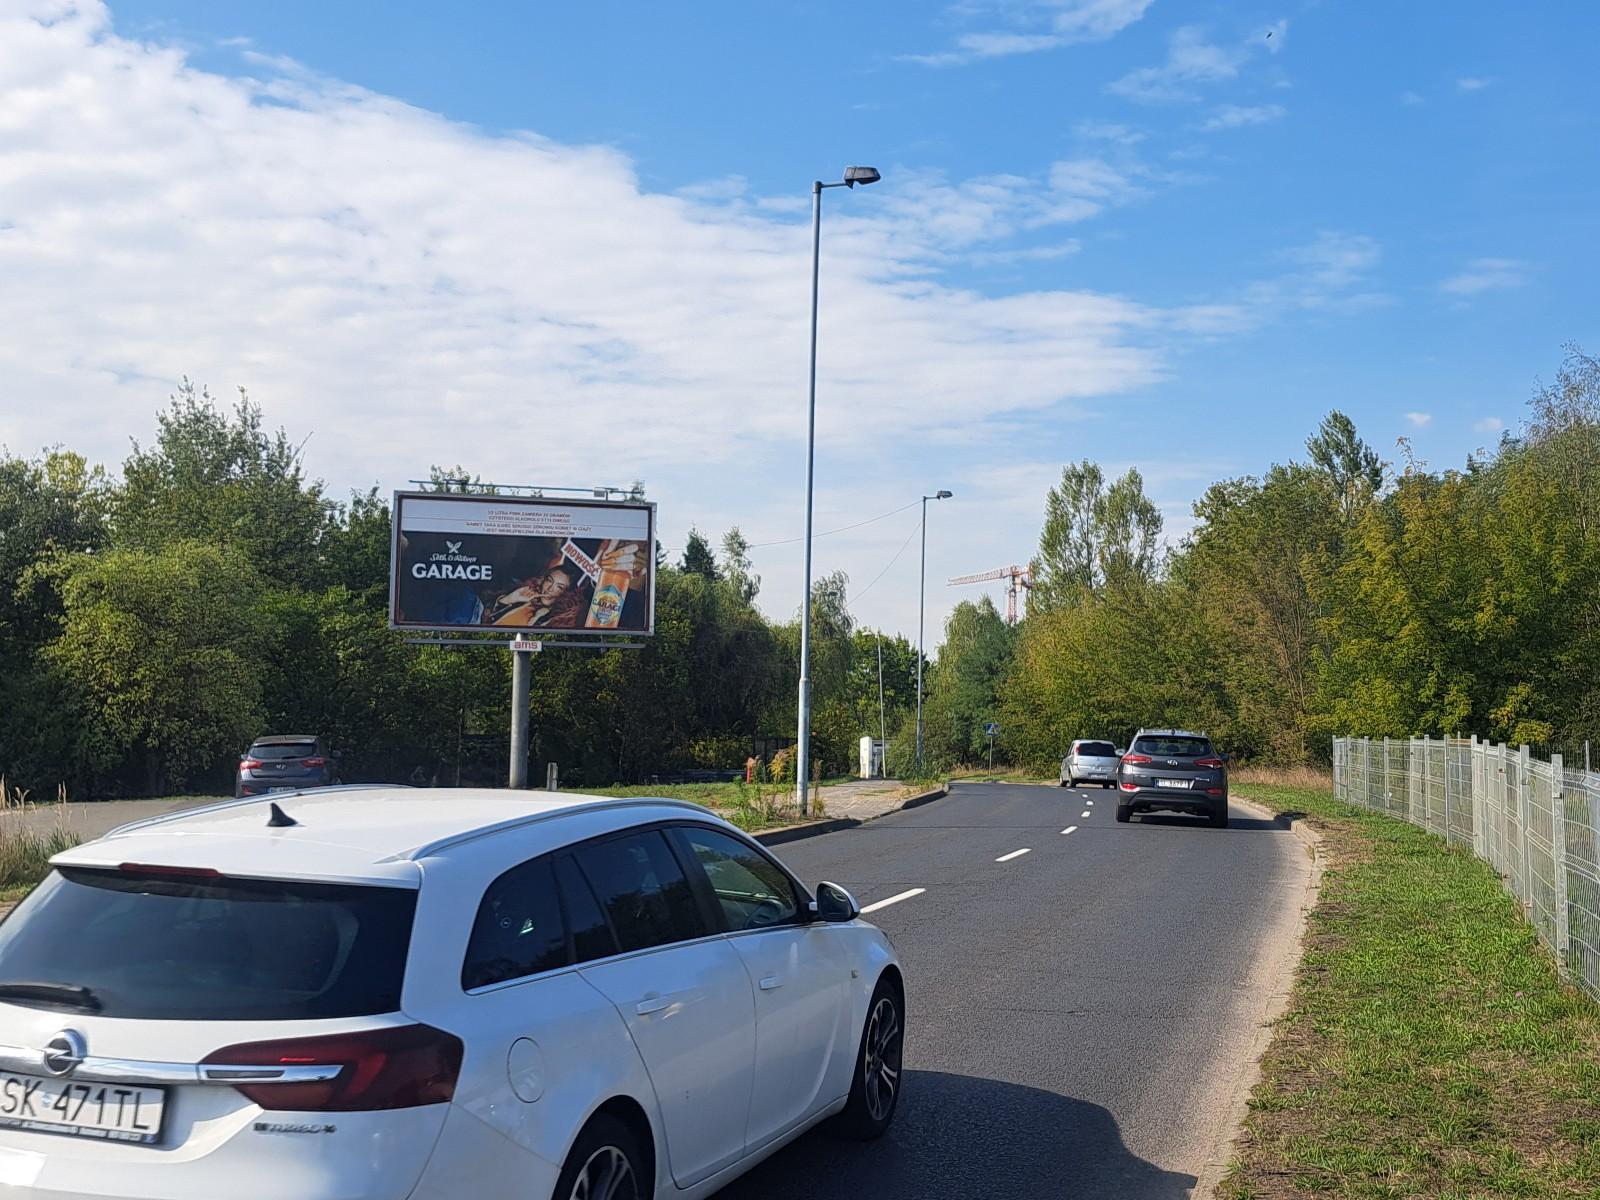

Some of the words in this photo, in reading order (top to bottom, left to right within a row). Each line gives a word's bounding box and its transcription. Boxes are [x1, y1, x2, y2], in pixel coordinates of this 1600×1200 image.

[412, 563, 492, 580] GARAGE
[514, 641, 538, 649] ams
[0, 1077, 43, 1117] SK
[53, 1083, 149, 1130] 471TL
